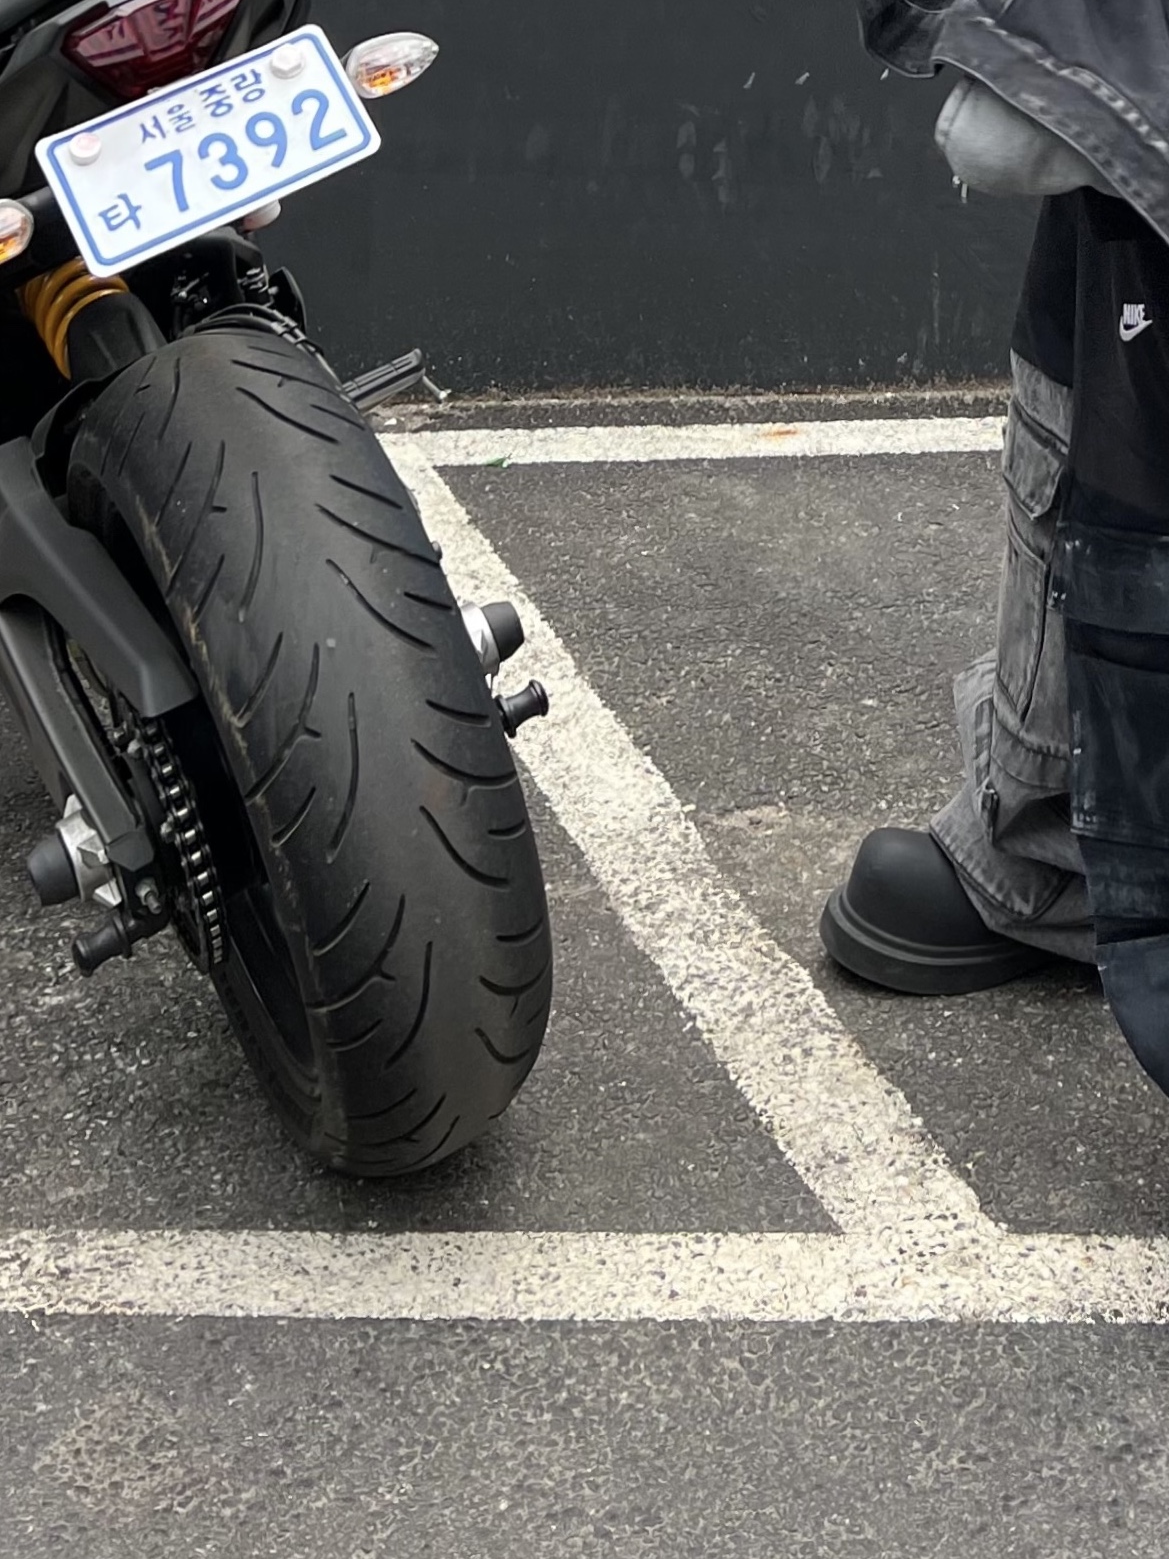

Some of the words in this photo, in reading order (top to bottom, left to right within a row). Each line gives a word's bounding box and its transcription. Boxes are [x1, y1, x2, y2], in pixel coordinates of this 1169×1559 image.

[98, 194, 143, 230] 타
[144, 89, 347, 212] 7392
[1122, 303, 1146, 325] NIKE
